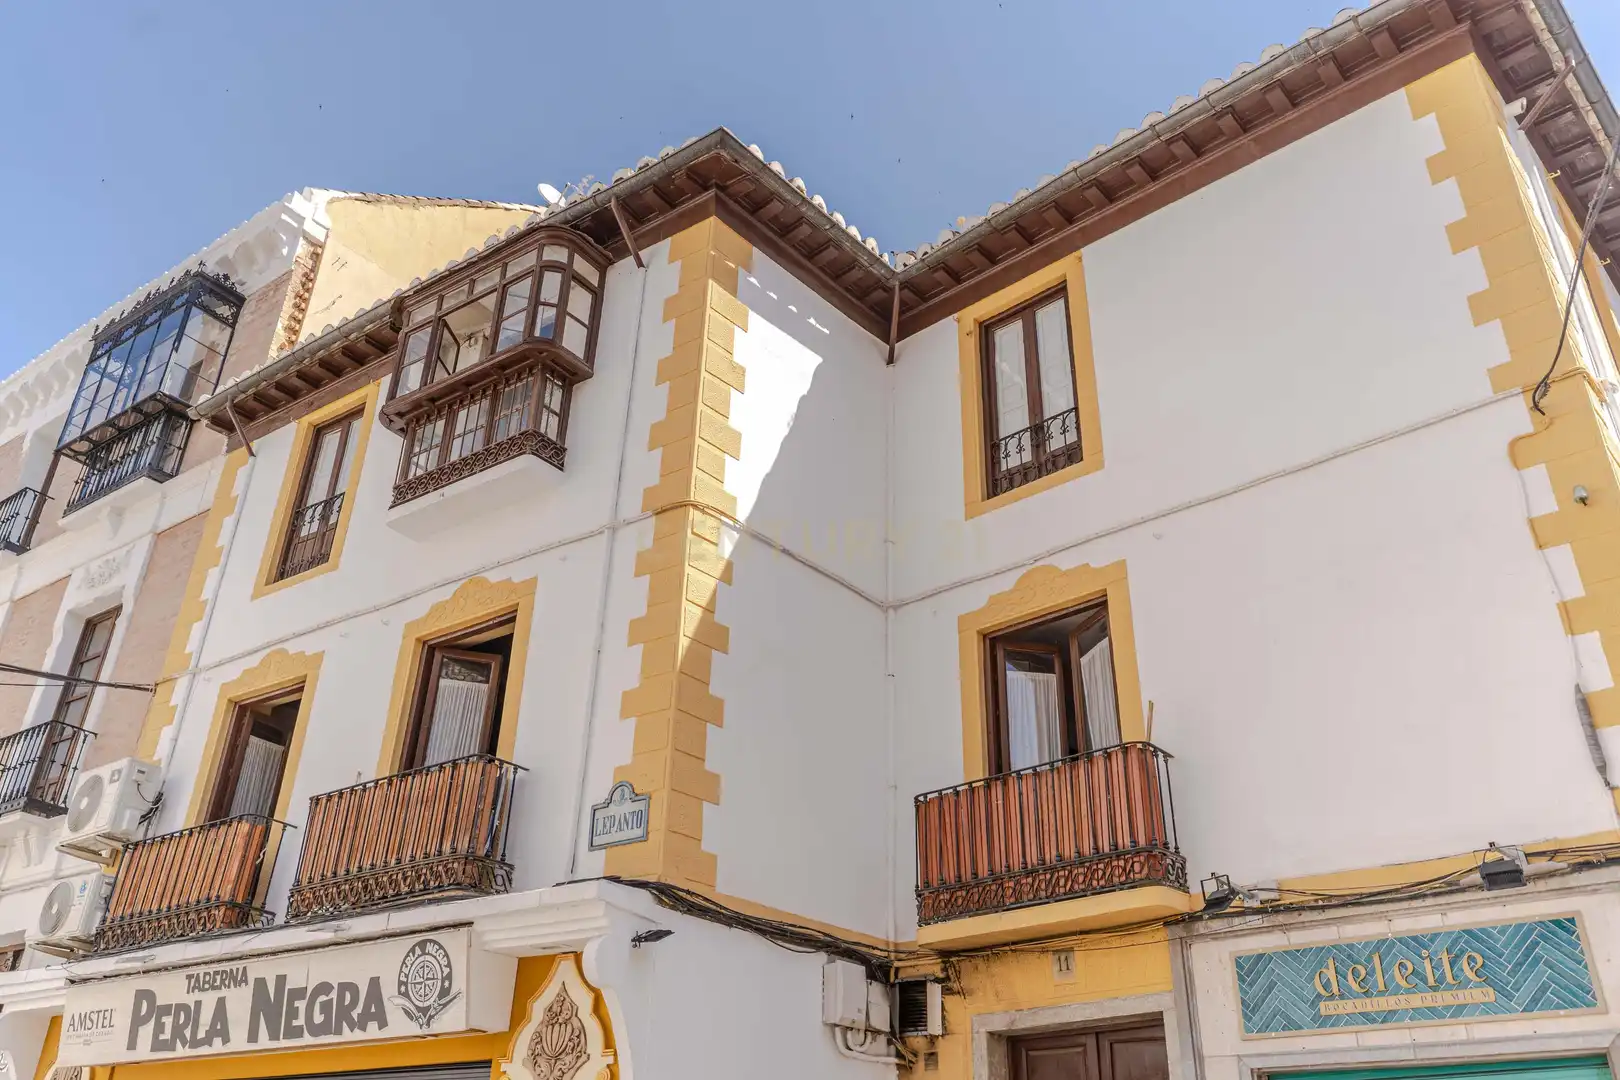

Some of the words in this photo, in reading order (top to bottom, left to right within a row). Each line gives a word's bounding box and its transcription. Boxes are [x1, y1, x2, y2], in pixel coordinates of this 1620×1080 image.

[594, 809, 643, 837] LEPANTO
[400, 946, 422, 982] PERLA
[426, 942, 450, 977] NEGRA
[557, 955, 573, 972] 11
[1314, 947, 1488, 997] deleite
[185, 966, 249, 995] TABERNA
[126, 988, 230, 1053] PERLA
[247, 974, 389, 1043] NEGRA
[1323, 997, 1412, 1013] BOCADILLOS
[67, 1008, 114, 1032] AMSTEL
